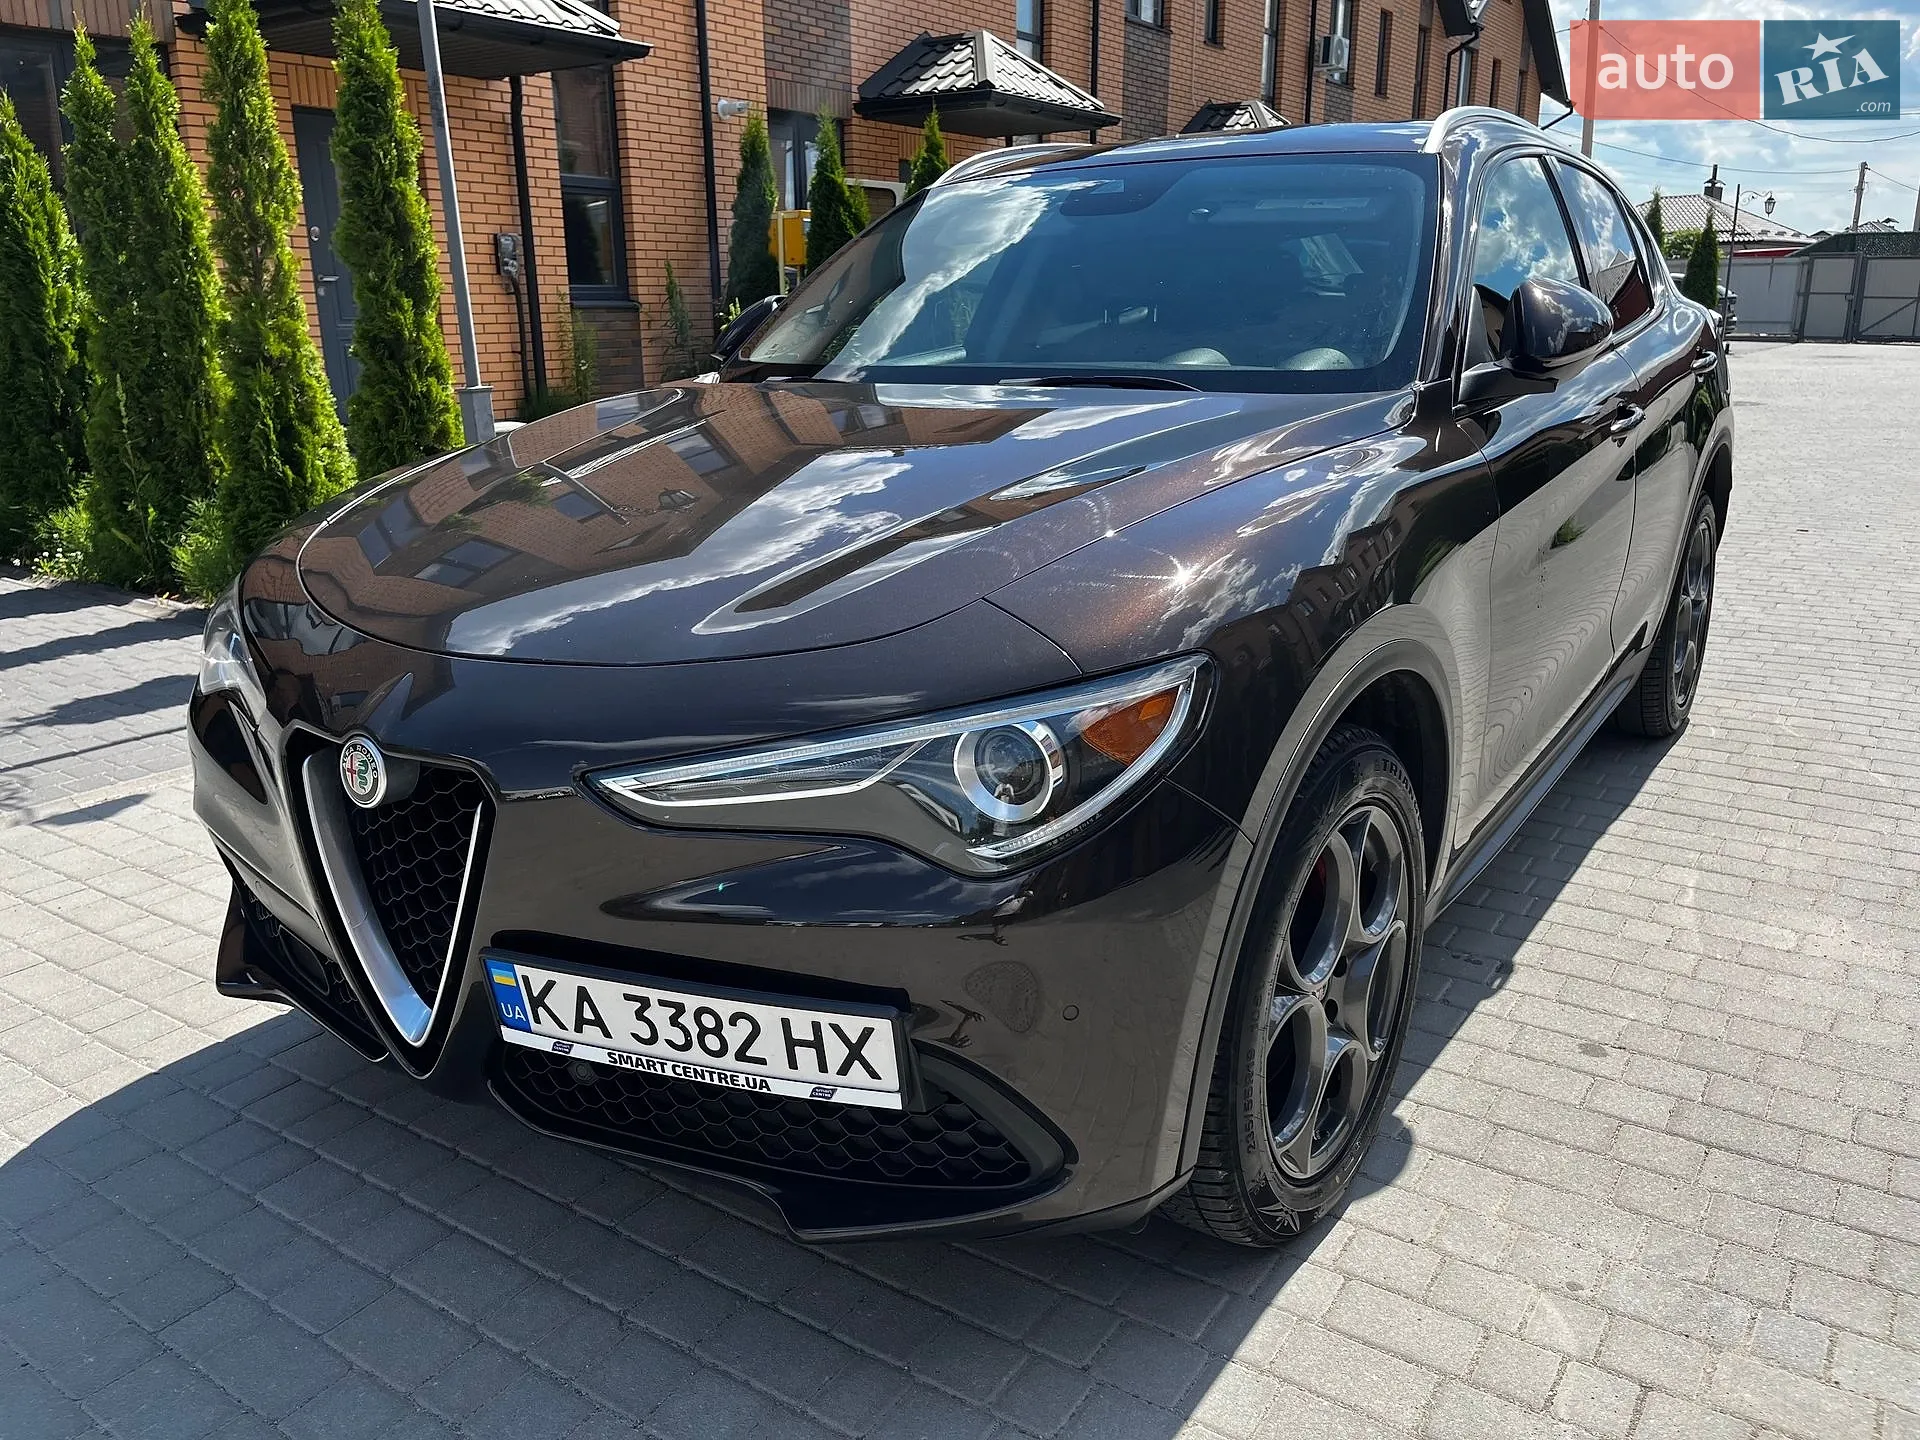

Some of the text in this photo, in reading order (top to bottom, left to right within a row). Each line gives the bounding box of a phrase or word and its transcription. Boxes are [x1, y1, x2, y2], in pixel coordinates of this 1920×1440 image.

[356, 745, 378, 779] ROMEO
[501, 1001, 526, 1022] UA
[521, 974, 882, 1081] KA 3382 HX
[606, 1051, 772, 1092] SMART CENTRE.UA
